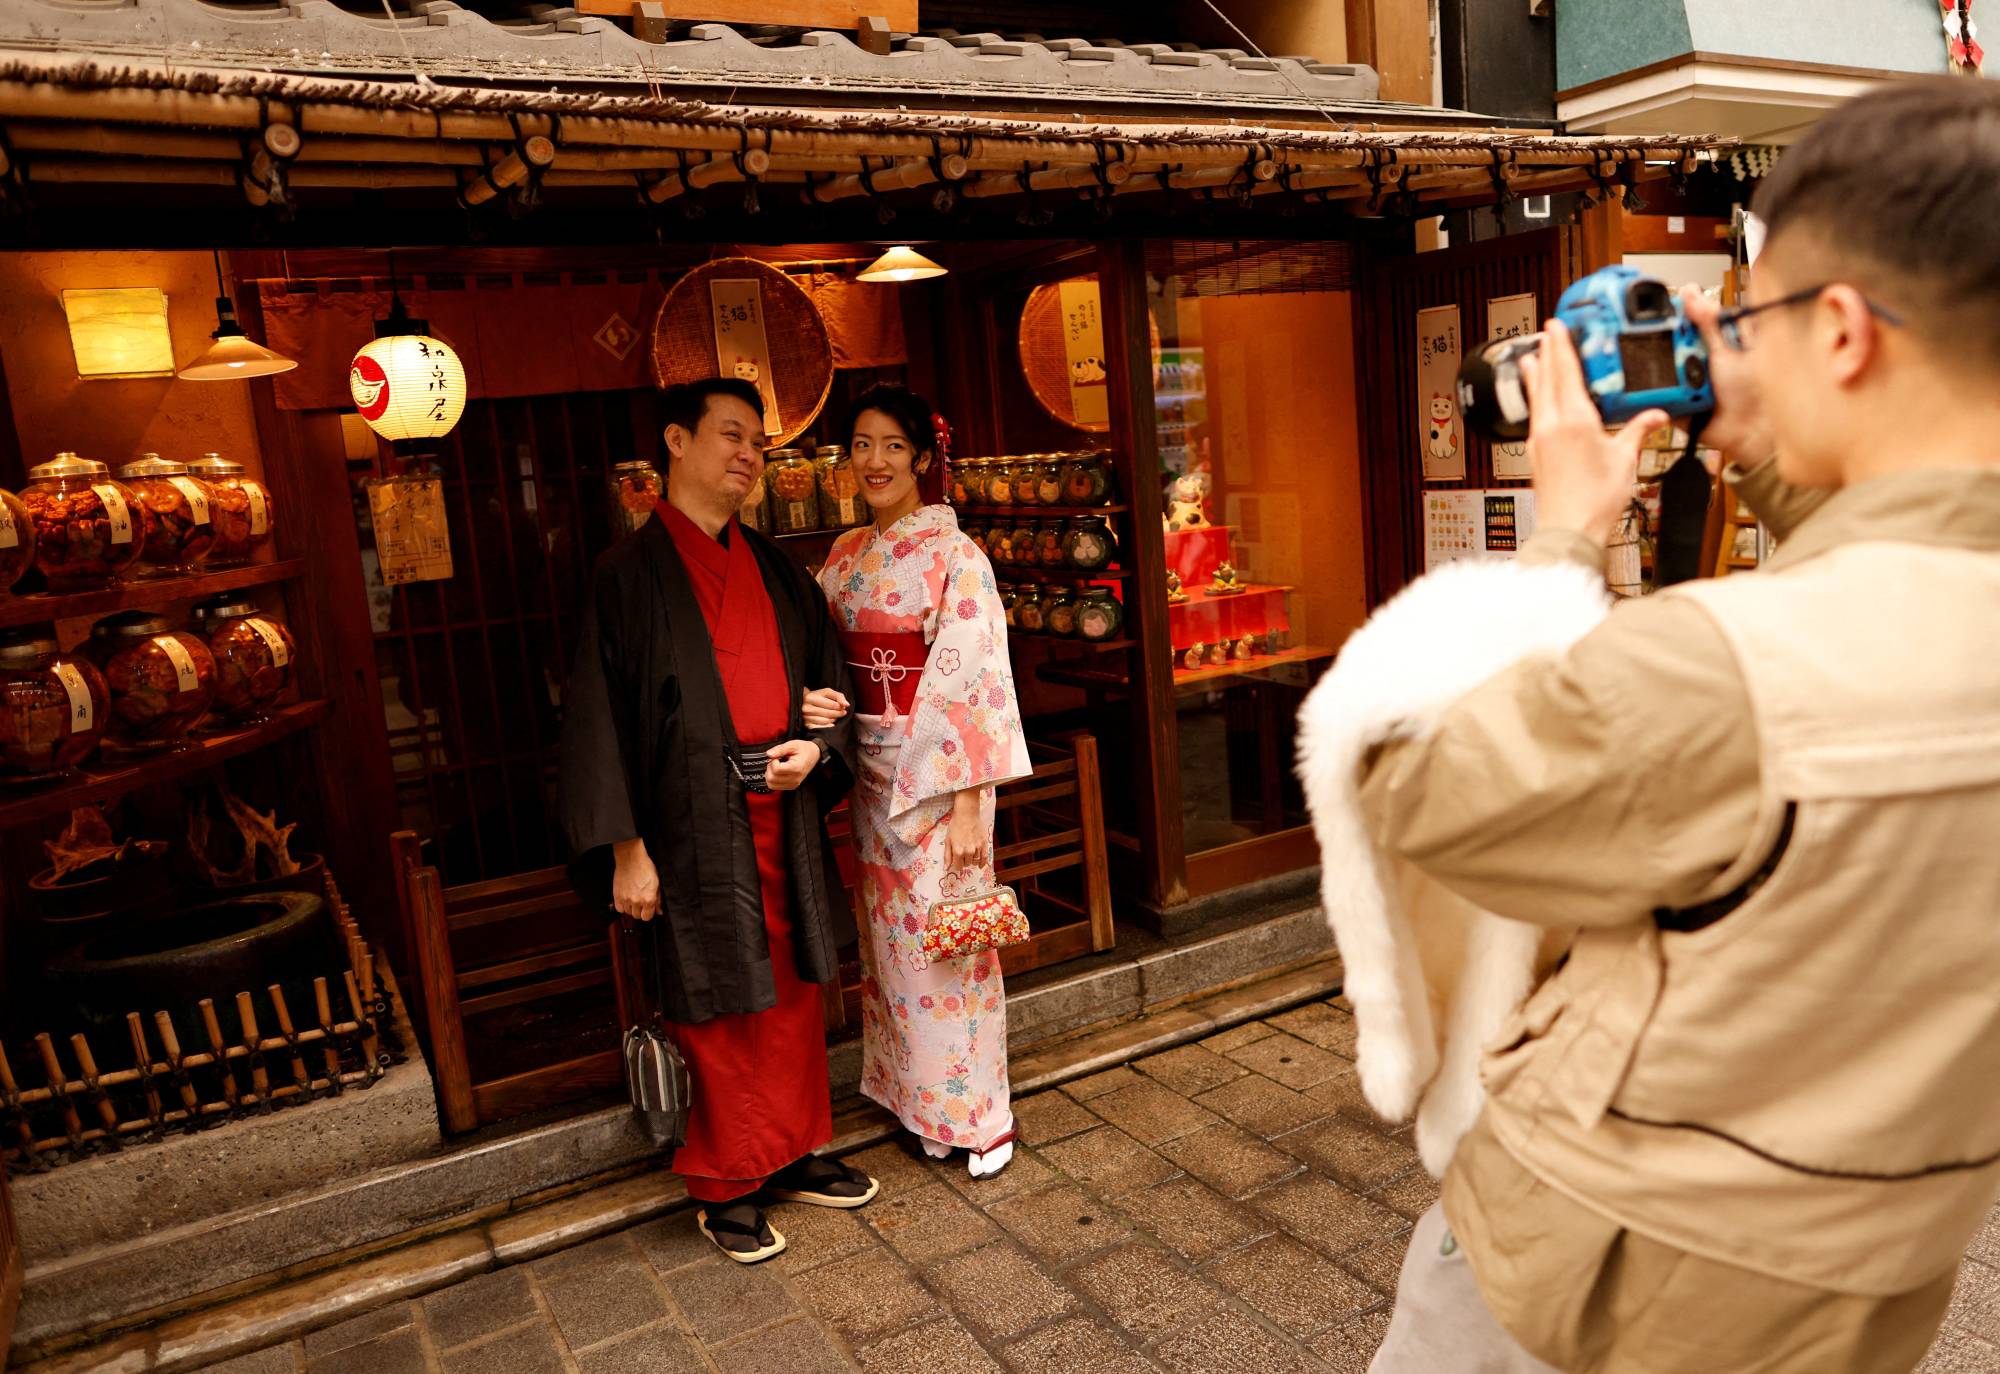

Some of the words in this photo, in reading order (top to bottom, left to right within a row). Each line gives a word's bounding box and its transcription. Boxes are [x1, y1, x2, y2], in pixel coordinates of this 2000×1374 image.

[719, 304, 730, 332] せんべい
[730, 305, 747, 321] 猫
[1422, 335, 1432, 367] せんべい
[1432, 335, 1447, 353] 猫
